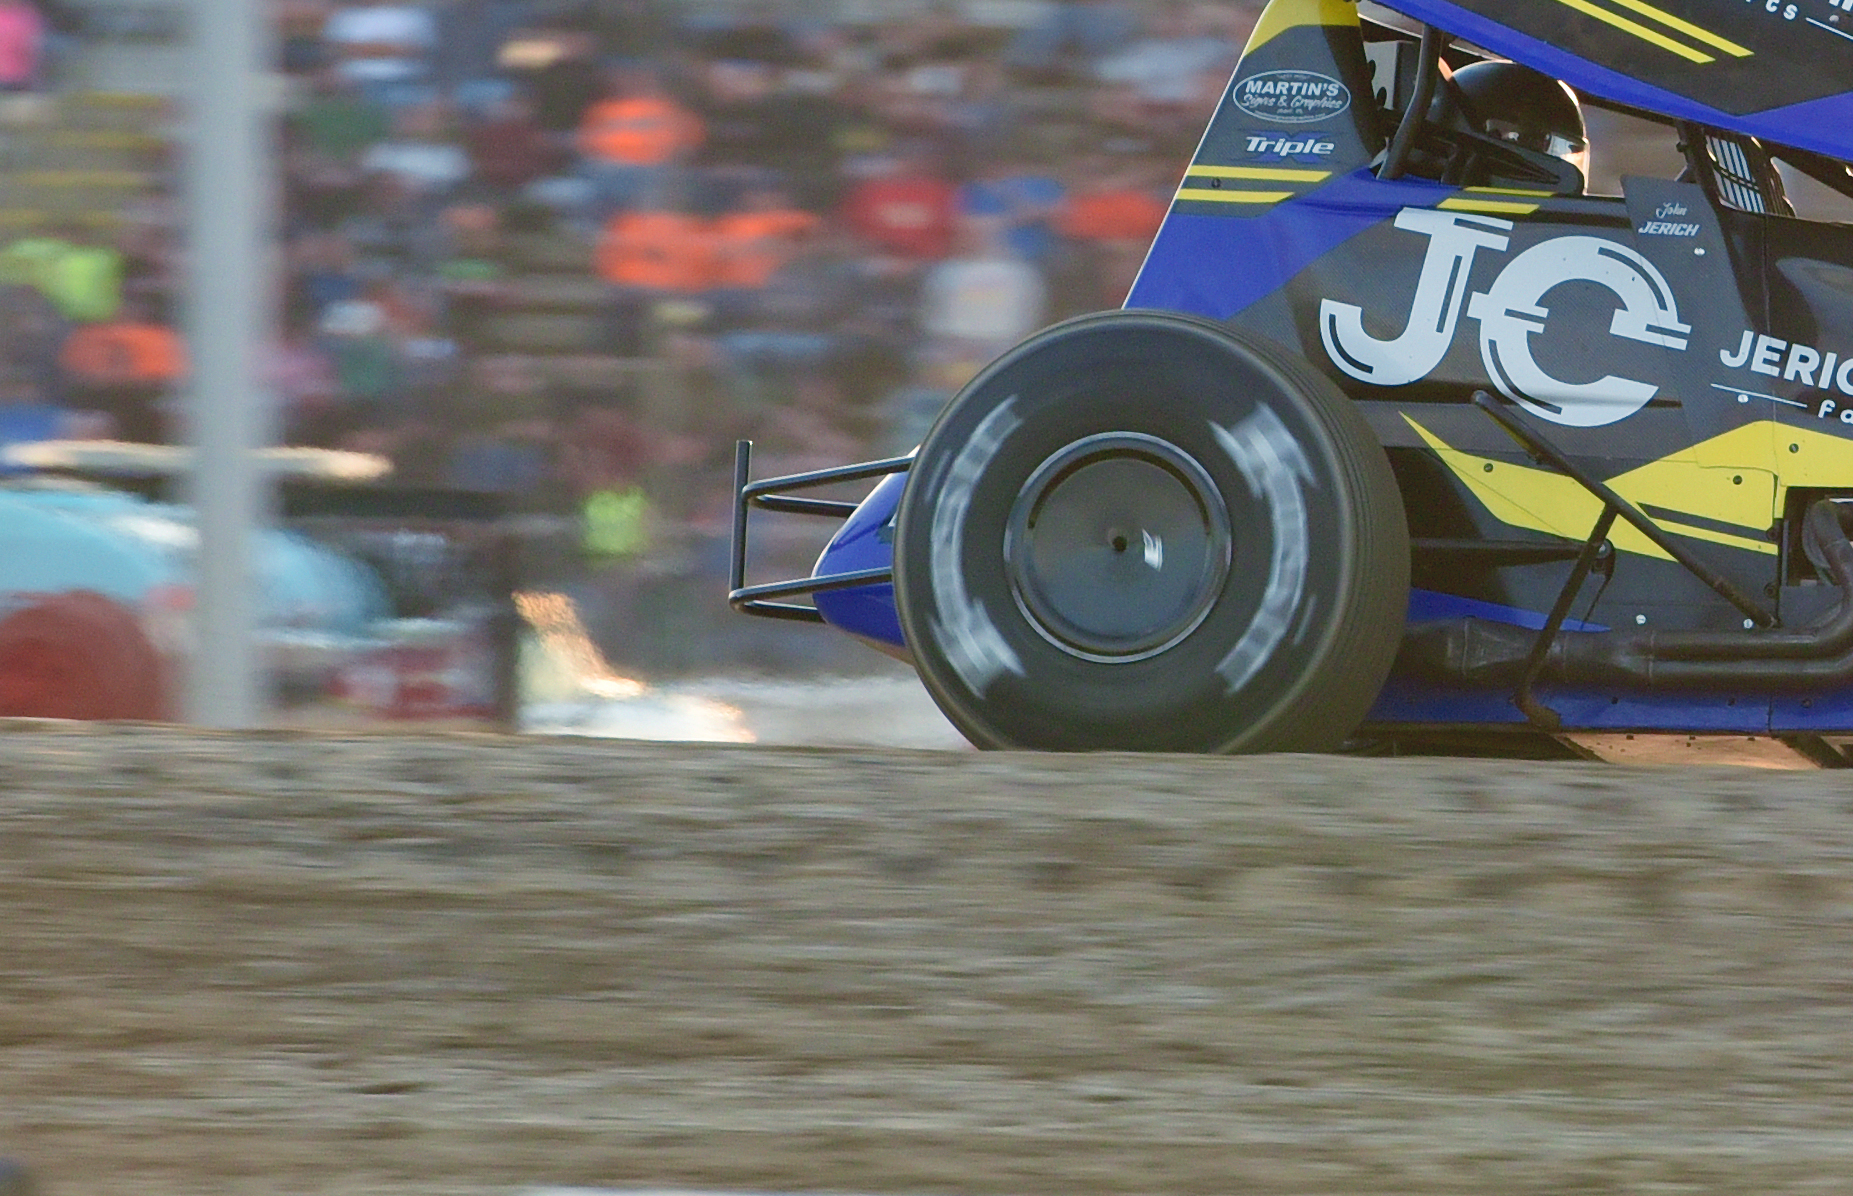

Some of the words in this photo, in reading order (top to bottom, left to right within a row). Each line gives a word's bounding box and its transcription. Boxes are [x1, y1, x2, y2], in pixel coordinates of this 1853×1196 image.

[1245, 80, 1340, 96] MARTIN'S
[1241, 93, 1276, 108] Signs
[1278, 95, 1288, 107] &
[1290, 95, 1343, 111] Graphics
[1245, 136, 1335, 156] Triple
[1655, 202, 1688, 219] John
[1638, 221, 1700, 236] JERICH
[1319, 206, 1692, 427] JC
